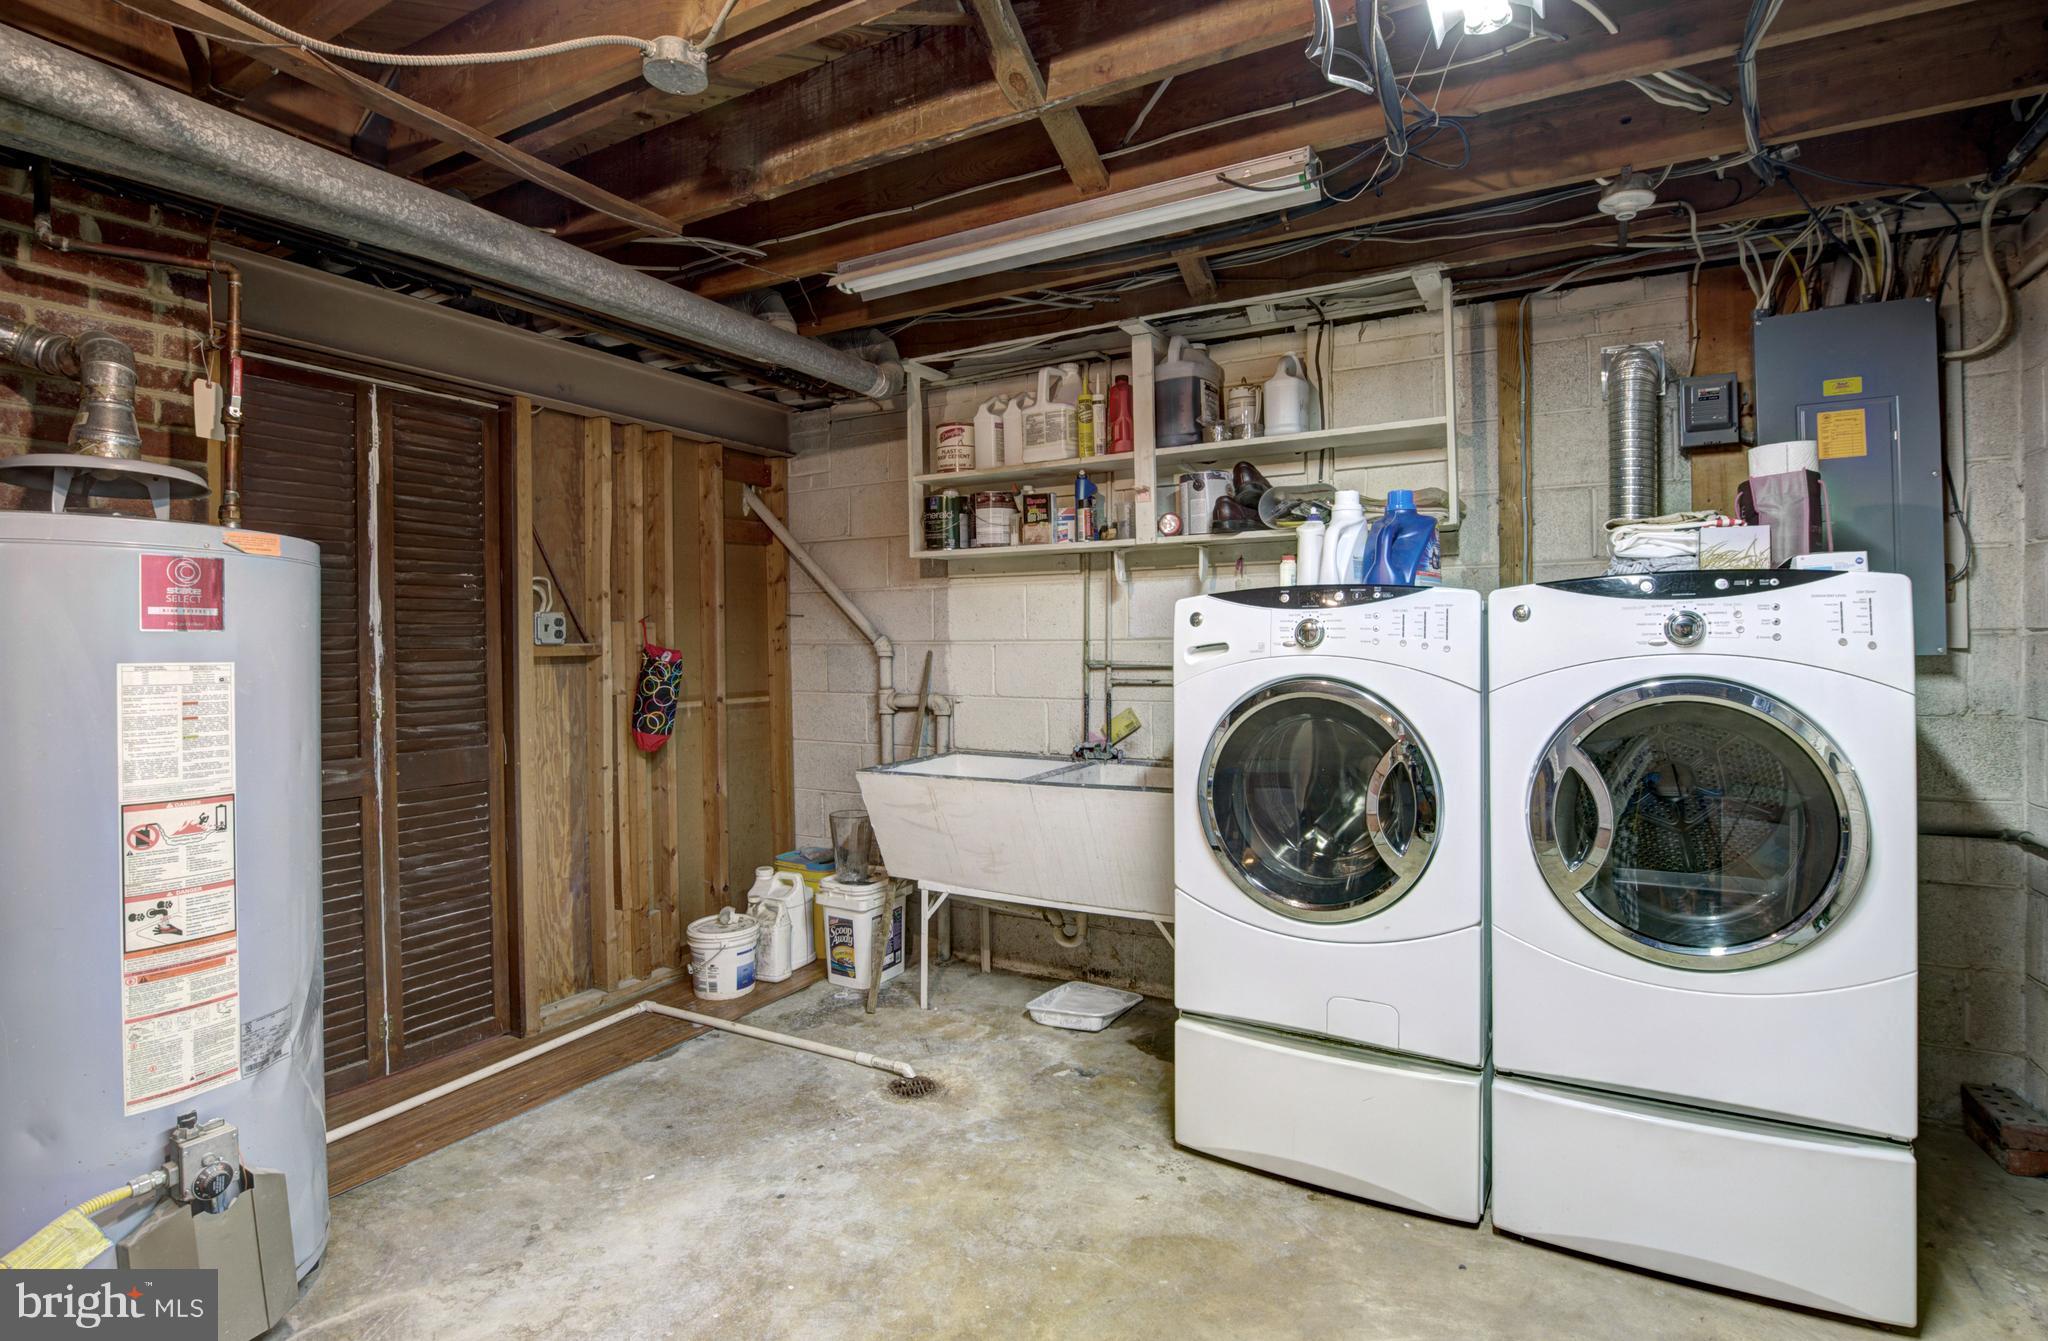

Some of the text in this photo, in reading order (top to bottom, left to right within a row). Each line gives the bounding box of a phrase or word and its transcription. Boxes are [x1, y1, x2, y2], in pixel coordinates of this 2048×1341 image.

[165, 594, 203, 604] SELECT
[175, 886, 203, 896] DANGER
[830, 926, 852, 938] Scoop
[831, 934, 853, 947] Away
